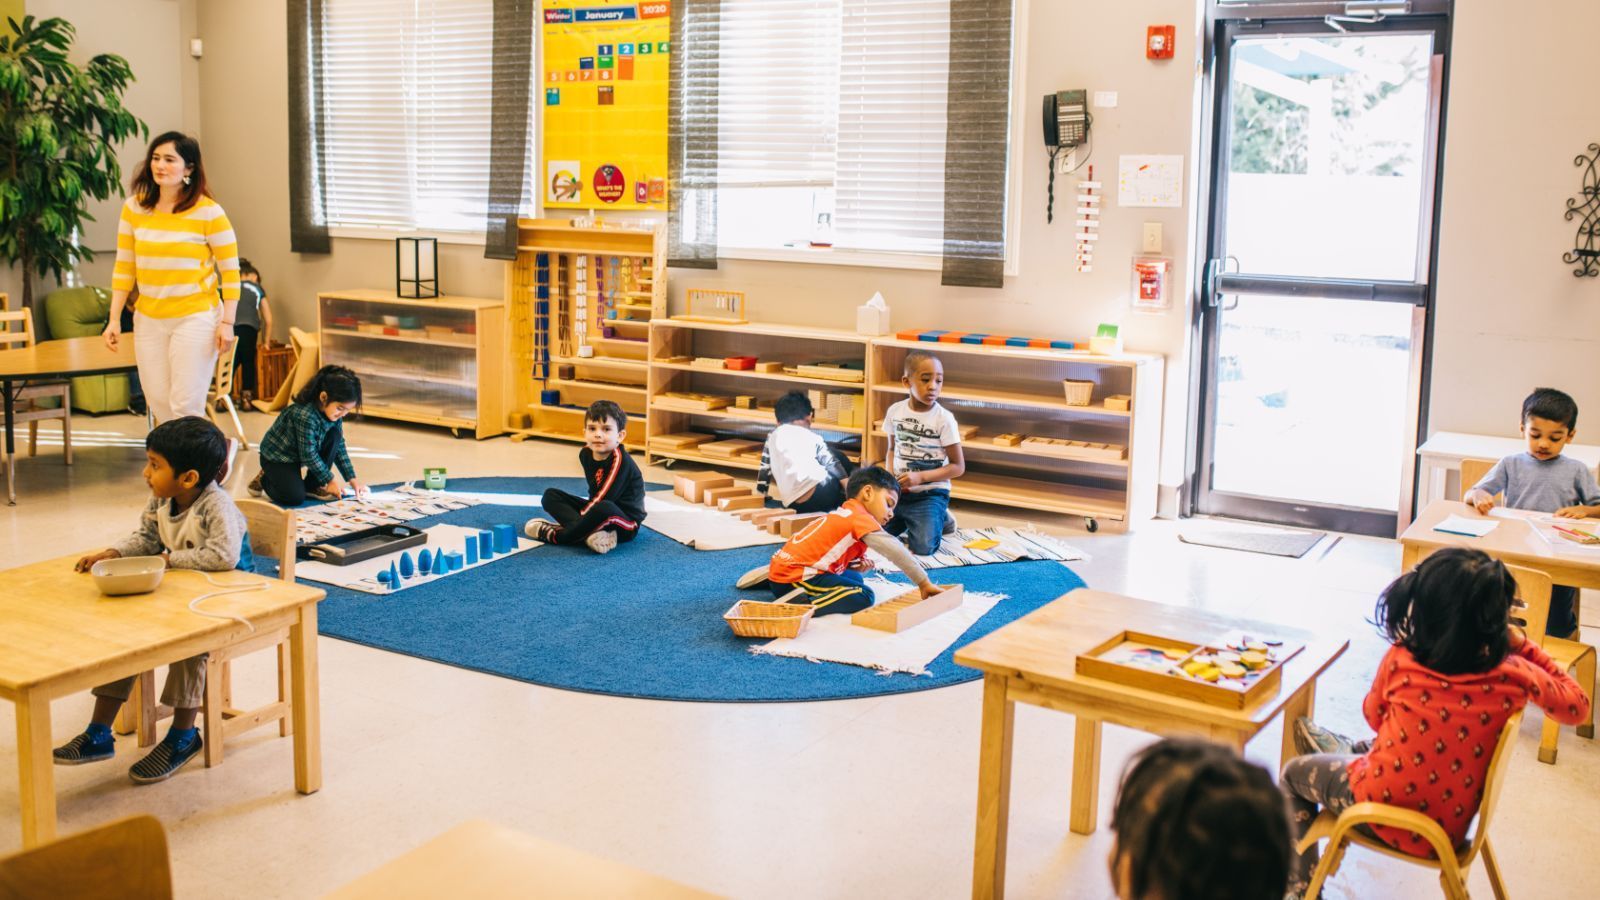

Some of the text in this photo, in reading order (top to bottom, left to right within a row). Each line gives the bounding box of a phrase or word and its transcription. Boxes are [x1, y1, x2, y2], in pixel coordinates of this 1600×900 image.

[546, 5, 667, 20] Winter January 2020
[623, 45, 630, 54] 2
[641, 44, 648, 53] 3
[568, 72, 575, 81] 6
[584, 71, 590, 80] 7
[602, 71, 609, 80] 8
